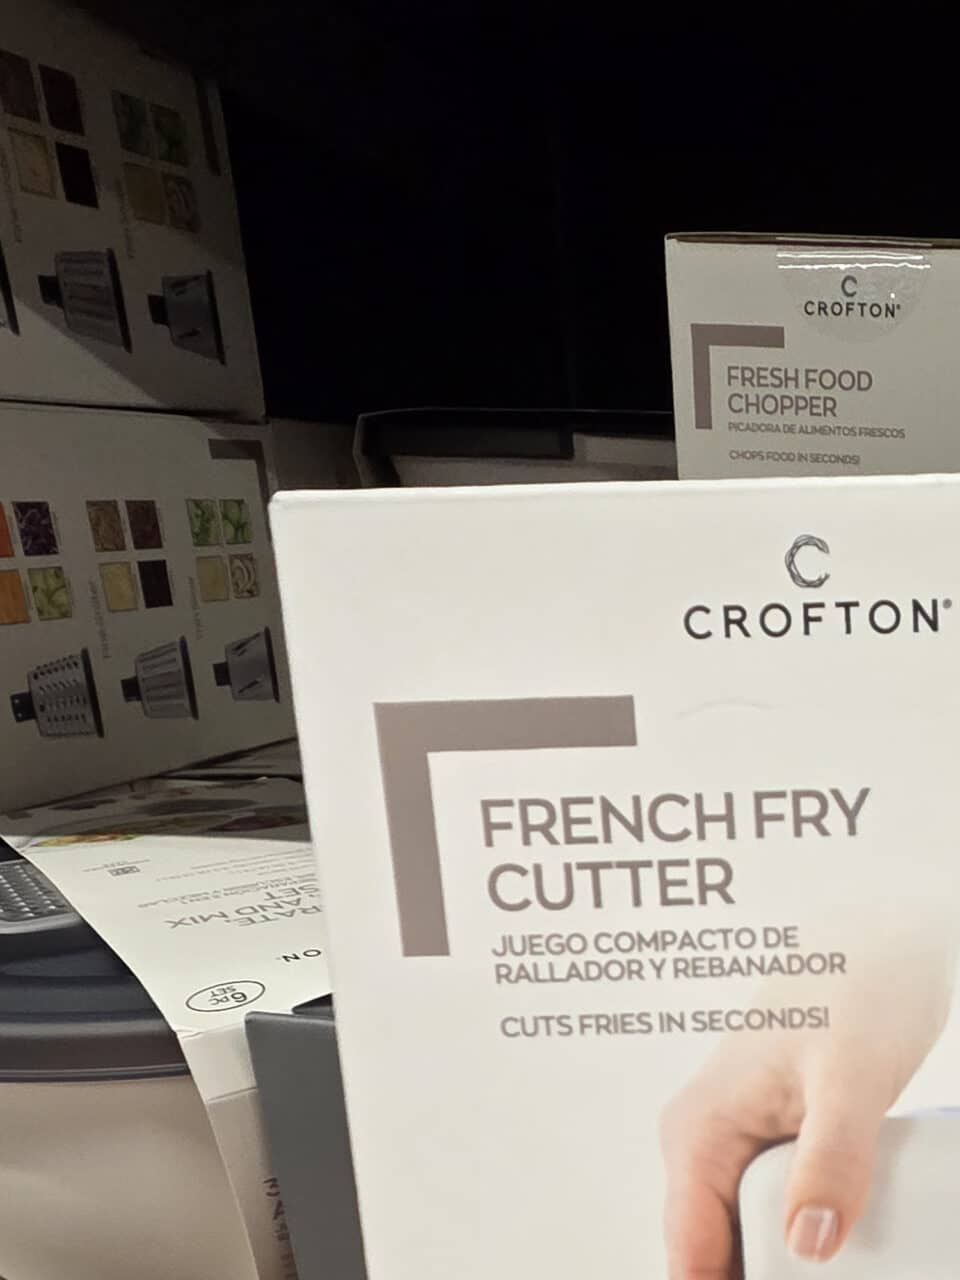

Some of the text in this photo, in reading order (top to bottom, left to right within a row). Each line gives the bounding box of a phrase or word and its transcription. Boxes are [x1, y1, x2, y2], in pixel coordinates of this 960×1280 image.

[727, 366, 873, 391] FRESH FOOD
[728, 393, 837, 417] CHOPPER
[728, 421, 905, 439] PICADORA DE ALIMENTOS FRESCOS
[729, 451, 860, 465] CHOPS FOOD IN SECONDS!
[480, 786, 871, 848] FRENCH FRY
[487, 857, 735, 912] CUTTER
[164, 911, 229, 929] MIX
[491, 926, 799, 957] JUEGO COMPACTO DE
[494, 952, 847, 984] RALLADOR Y REBANADOR
[500, 1006, 830, 1038] CUTS FRIES IN SECONDS!
